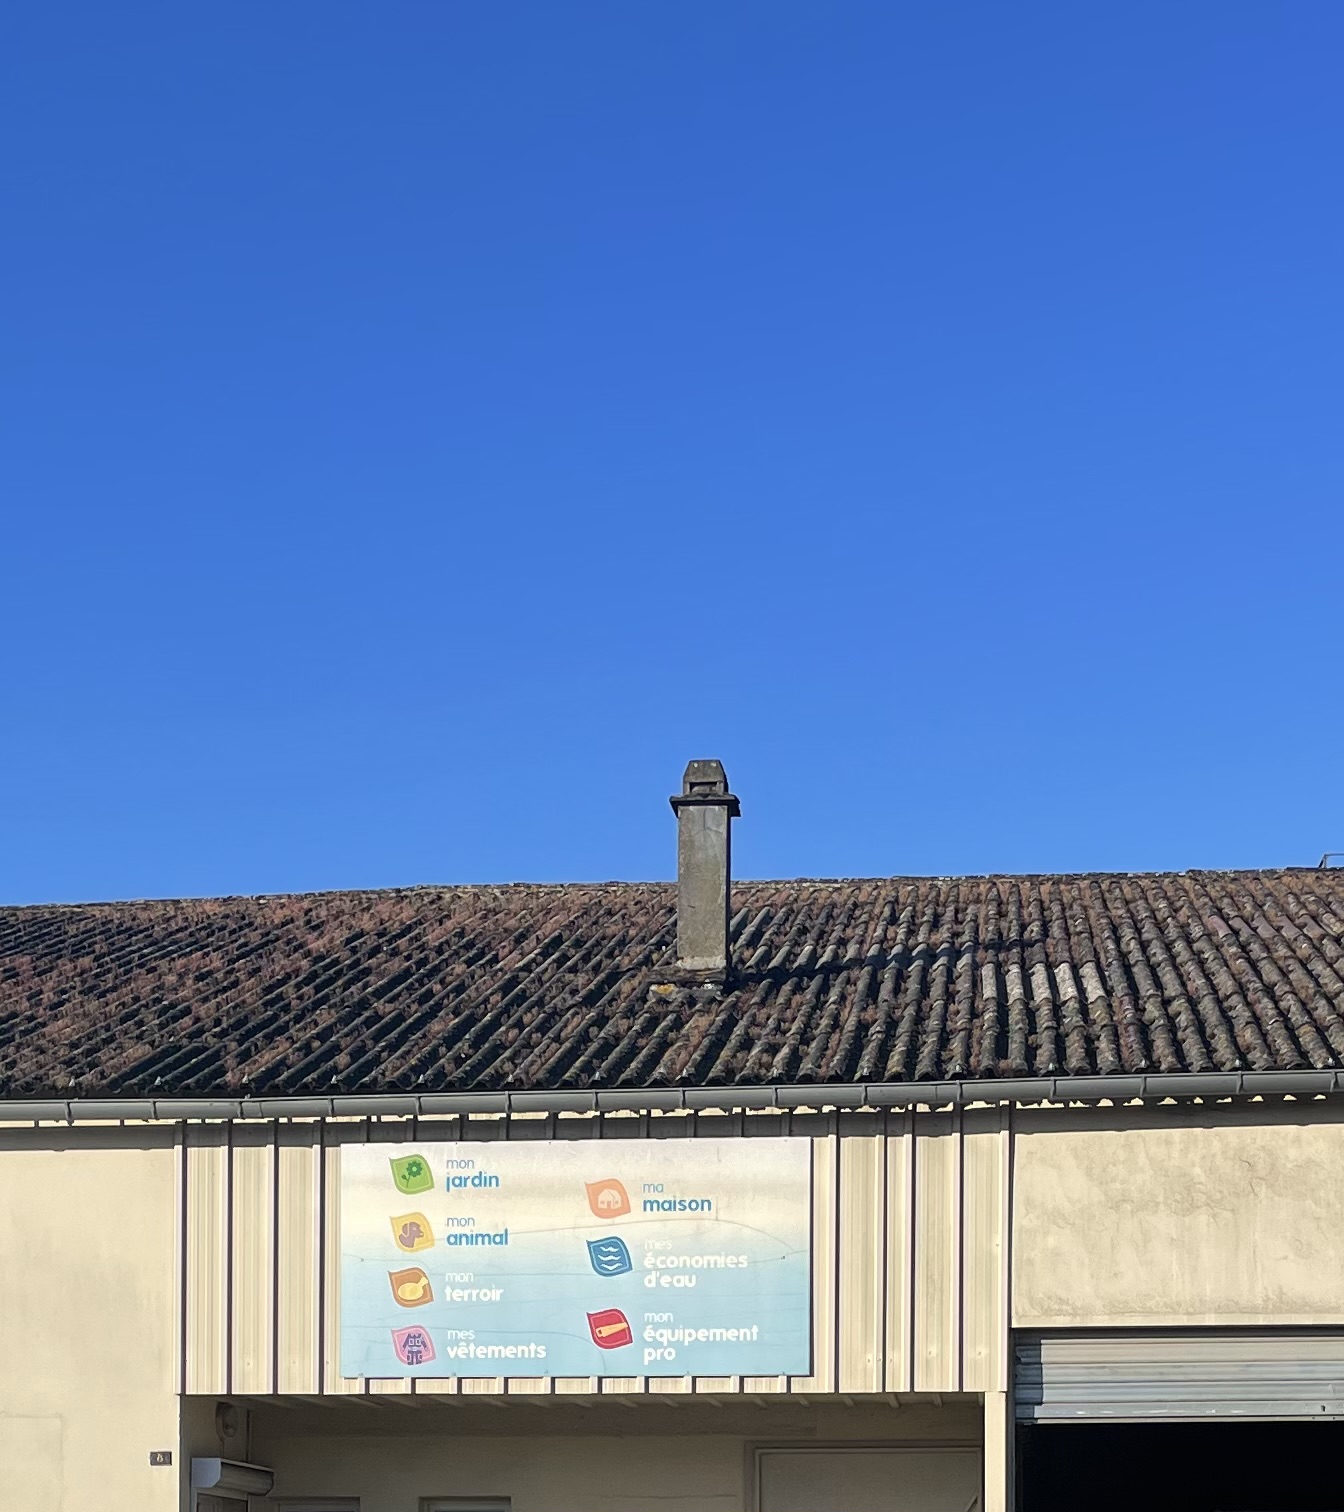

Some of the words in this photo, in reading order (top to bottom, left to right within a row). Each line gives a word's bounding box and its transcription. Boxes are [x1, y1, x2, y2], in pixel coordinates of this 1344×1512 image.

[446, 1159, 475, 1169] mon
[446, 1170, 500, 1192] jardin
[642, 1183, 664, 1193] ma
[642, 1194, 712, 1212] maison
[446, 1217, 476, 1227] mon
[446, 1227, 509, 1246] animal
[644, 1239, 673, 1250] mes
[643, 1251, 749, 1269] économies
[445, 1272, 474, 1283] mon
[643, 1270, 697, 1288] d'eau
[444, 1284, 505, 1302] terroir
[644, 1312, 674, 1323] mon
[447, 1329, 476, 1340] mes
[642, 1324, 759, 1346] équipement
[446, 1341, 547, 1359] vêtements
[643, 1347, 677, 1366] pro
